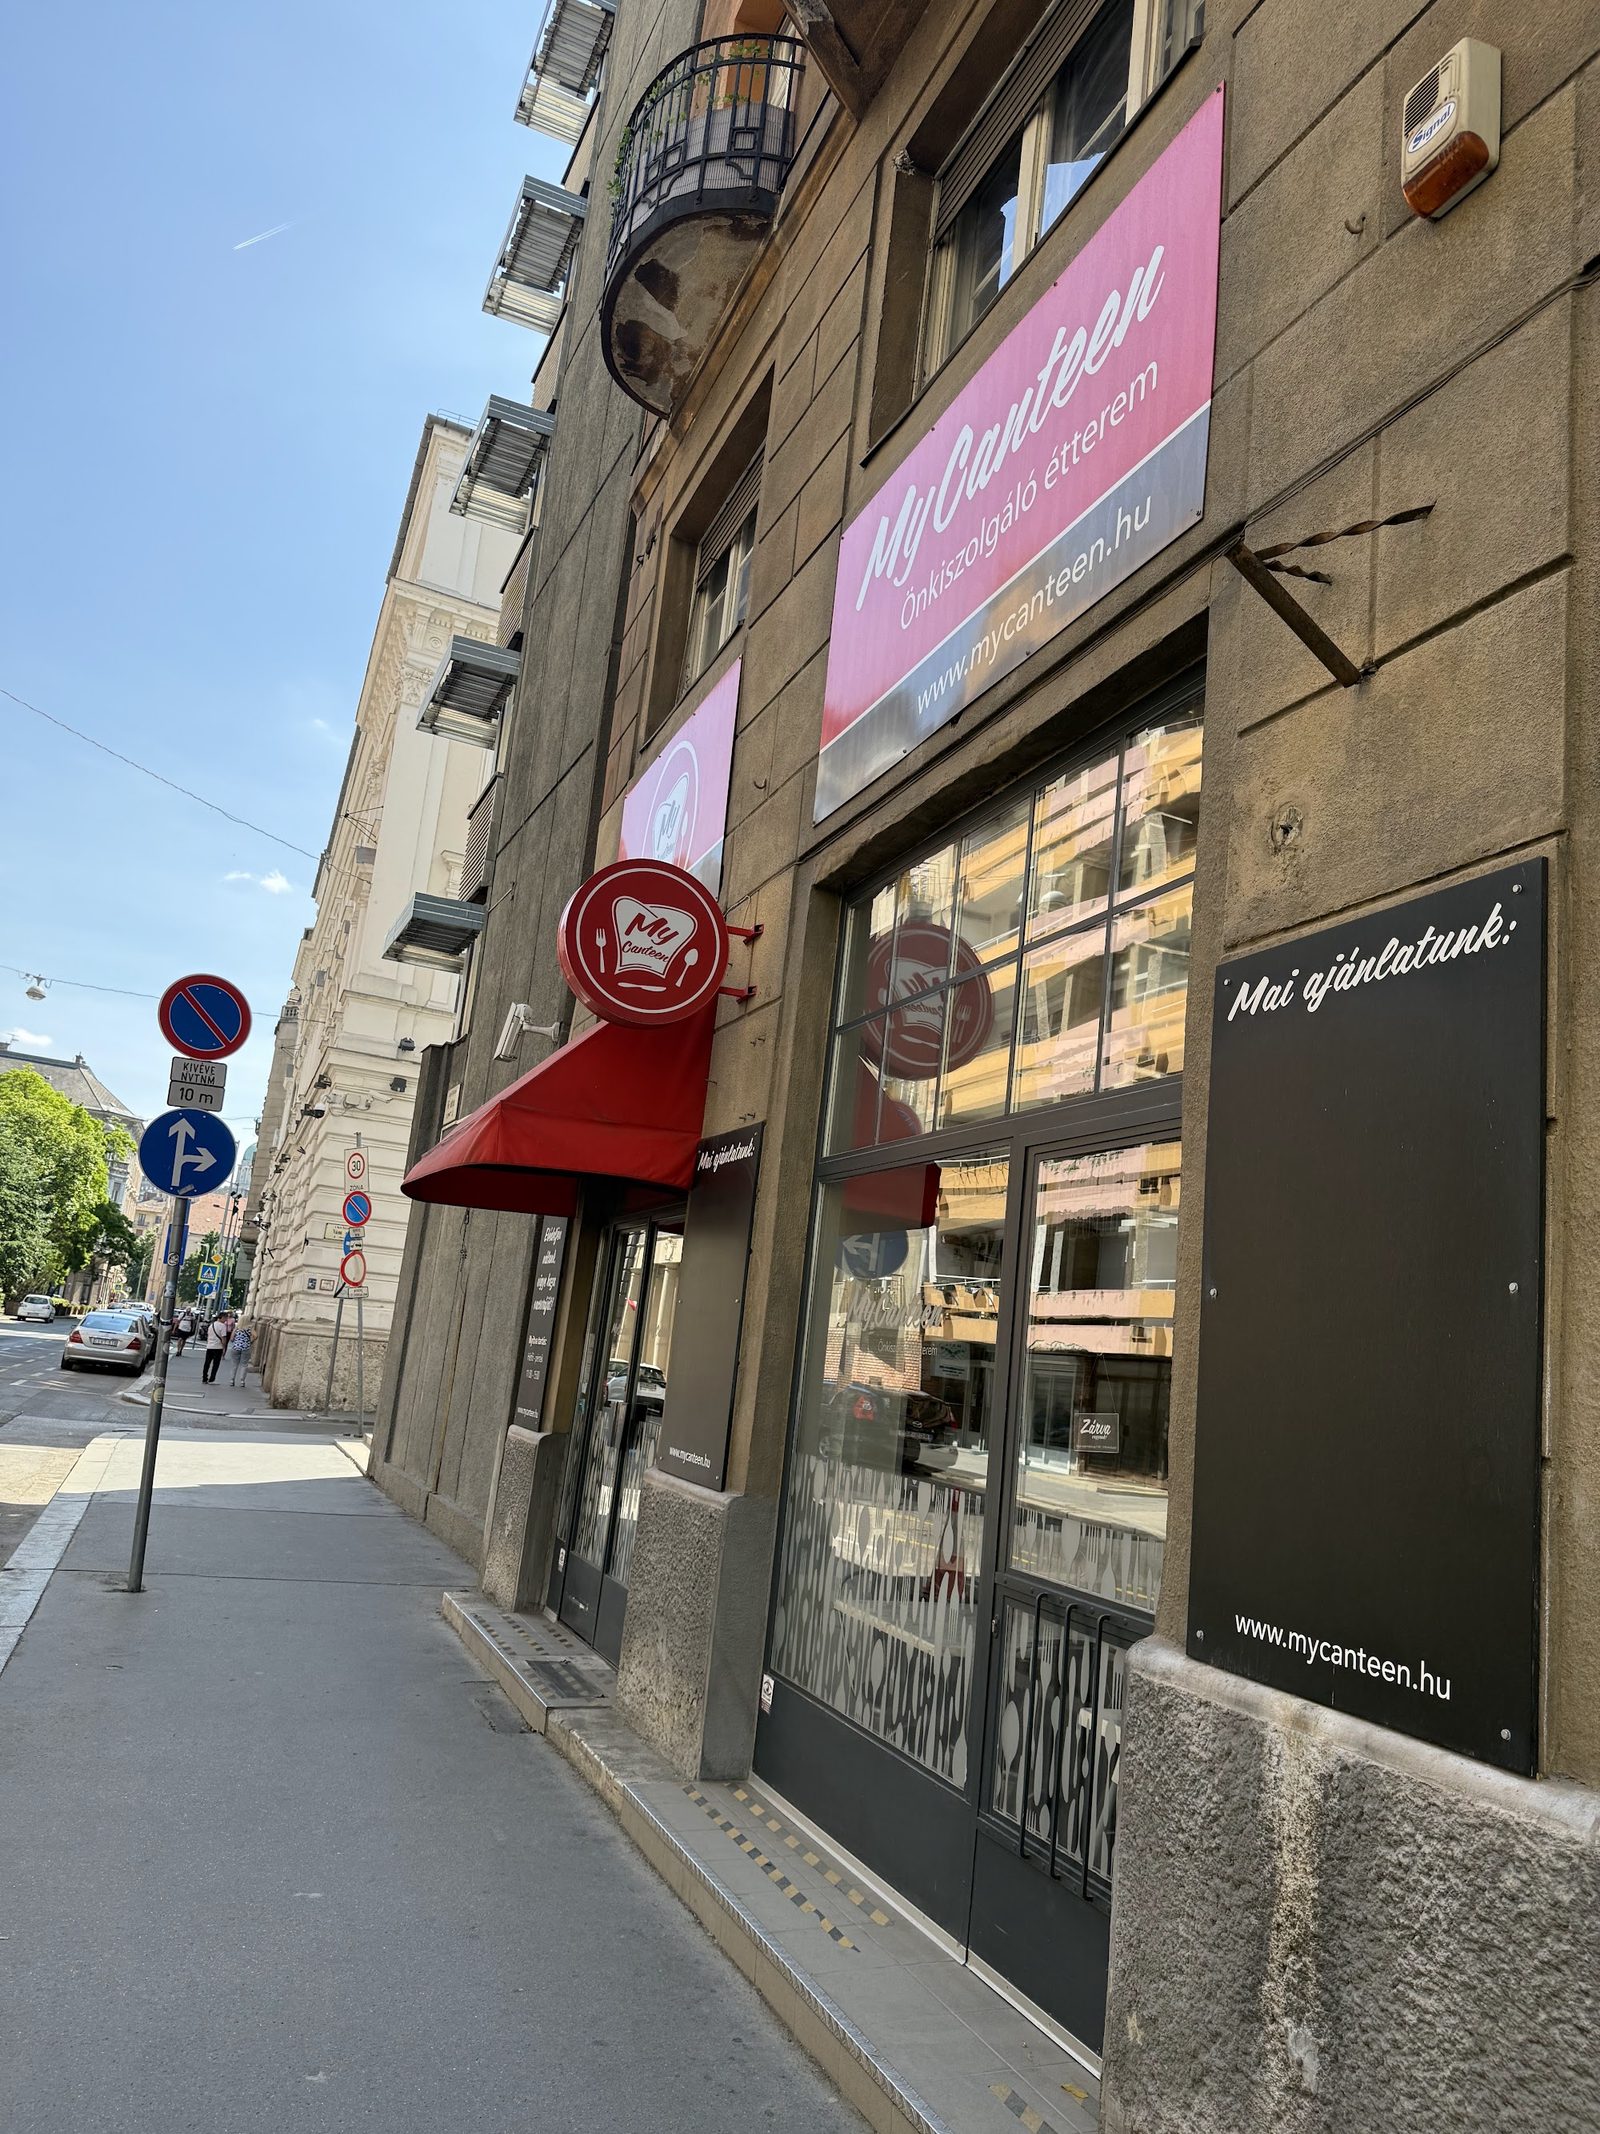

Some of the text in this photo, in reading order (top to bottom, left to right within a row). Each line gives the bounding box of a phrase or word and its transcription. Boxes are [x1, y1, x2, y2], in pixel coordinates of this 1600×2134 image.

[1412, 104, 1451, 150] Signal
[900, 360, 1159, 631] Önkiszolgáló étterem
[917, 495, 1152, 715] www.mycanteen.hu
[623, 912, 679, 945] My
[621, 940, 671, 963] Canteen
[1227, 902, 1518, 1022] Mai ajánlatunk:
[181, 1072, 216, 1085] NVTNM
[183, 1062, 216, 1075] KIVÉVE
[179, 1087, 213, 1104] 10 m
[351, 1160, 361, 1171] 30
[697, 1150, 714, 1171] Mai
[1080, 1418, 1112, 1436] Zárva
[669, 1447, 711, 1469] www.mycanteen.hu
